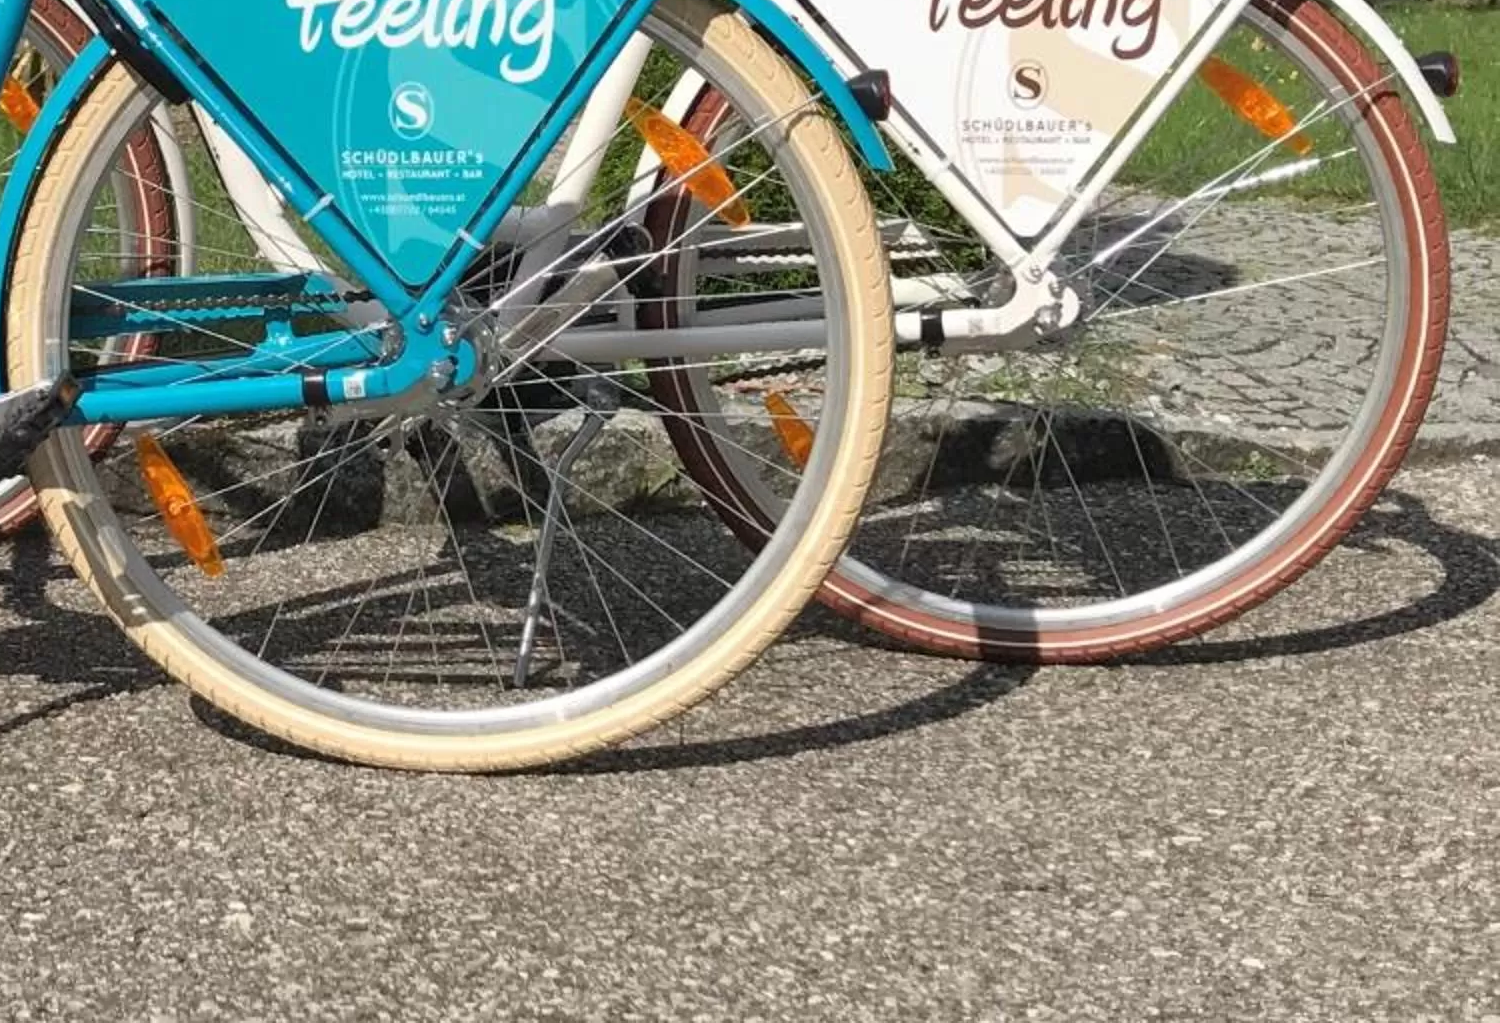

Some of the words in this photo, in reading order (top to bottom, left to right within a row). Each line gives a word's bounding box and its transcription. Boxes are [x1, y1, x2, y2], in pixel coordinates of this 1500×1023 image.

[1013, 66, 1042, 100] S
[395, 90, 428, 128] S
[341, 148, 484, 165] SCHÜDLBAUER's
[342, 168, 375, 179] HOTEL
[387, 168, 452, 179] RESTAURANT
[461, 168, 483, 179] BAR
